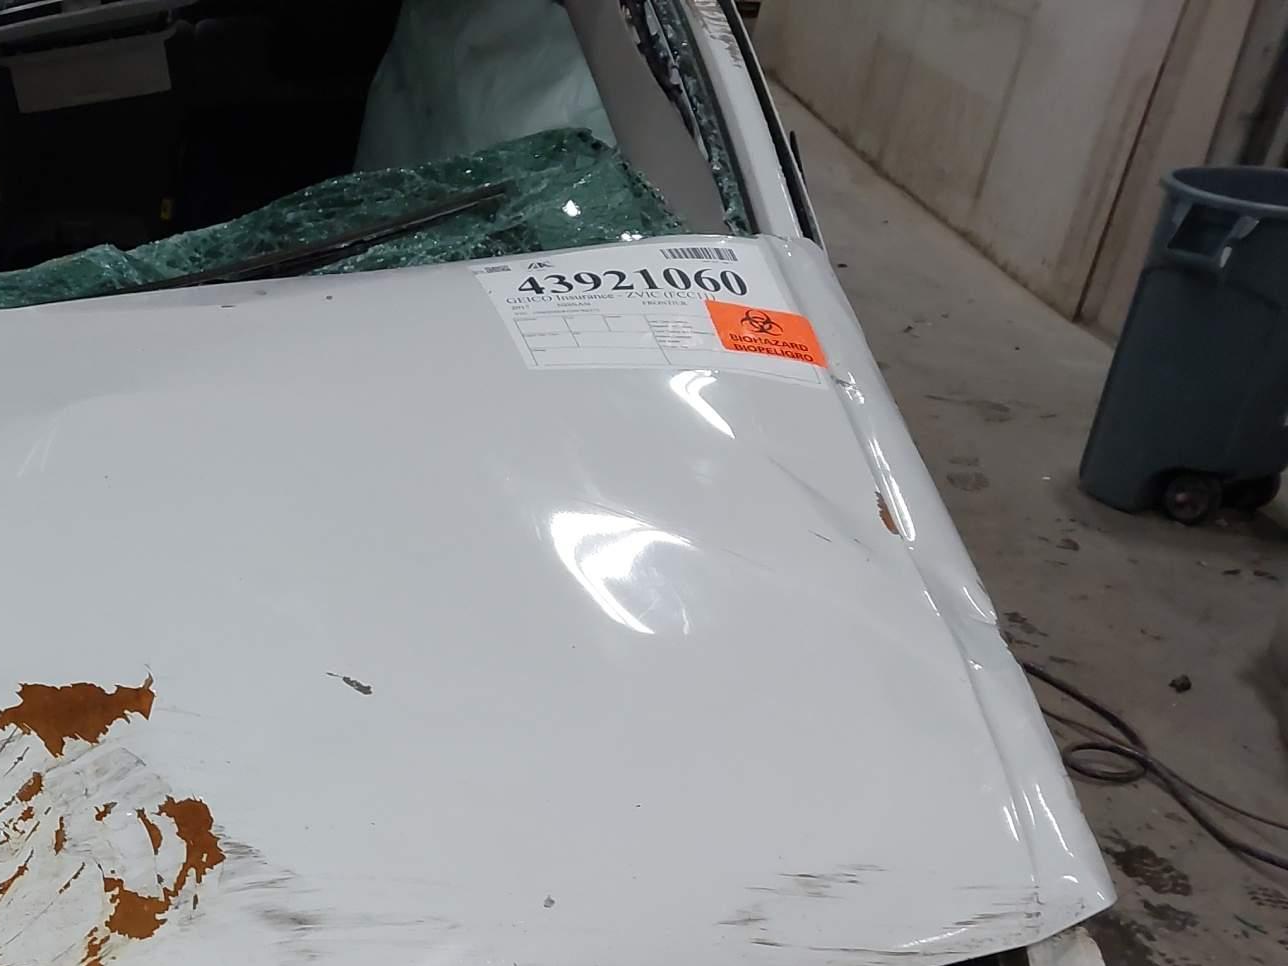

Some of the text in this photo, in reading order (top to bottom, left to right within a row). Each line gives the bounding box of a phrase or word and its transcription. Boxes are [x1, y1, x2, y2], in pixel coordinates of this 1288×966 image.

[518, 267, 748, 296] 43921060
[506, 294, 553, 305] GEICO
[555, 292, 615, 302] Insurance
[728, 332, 809, 352] BIOHAZARD
[733, 343, 814, 362] BIOPELIGRO
